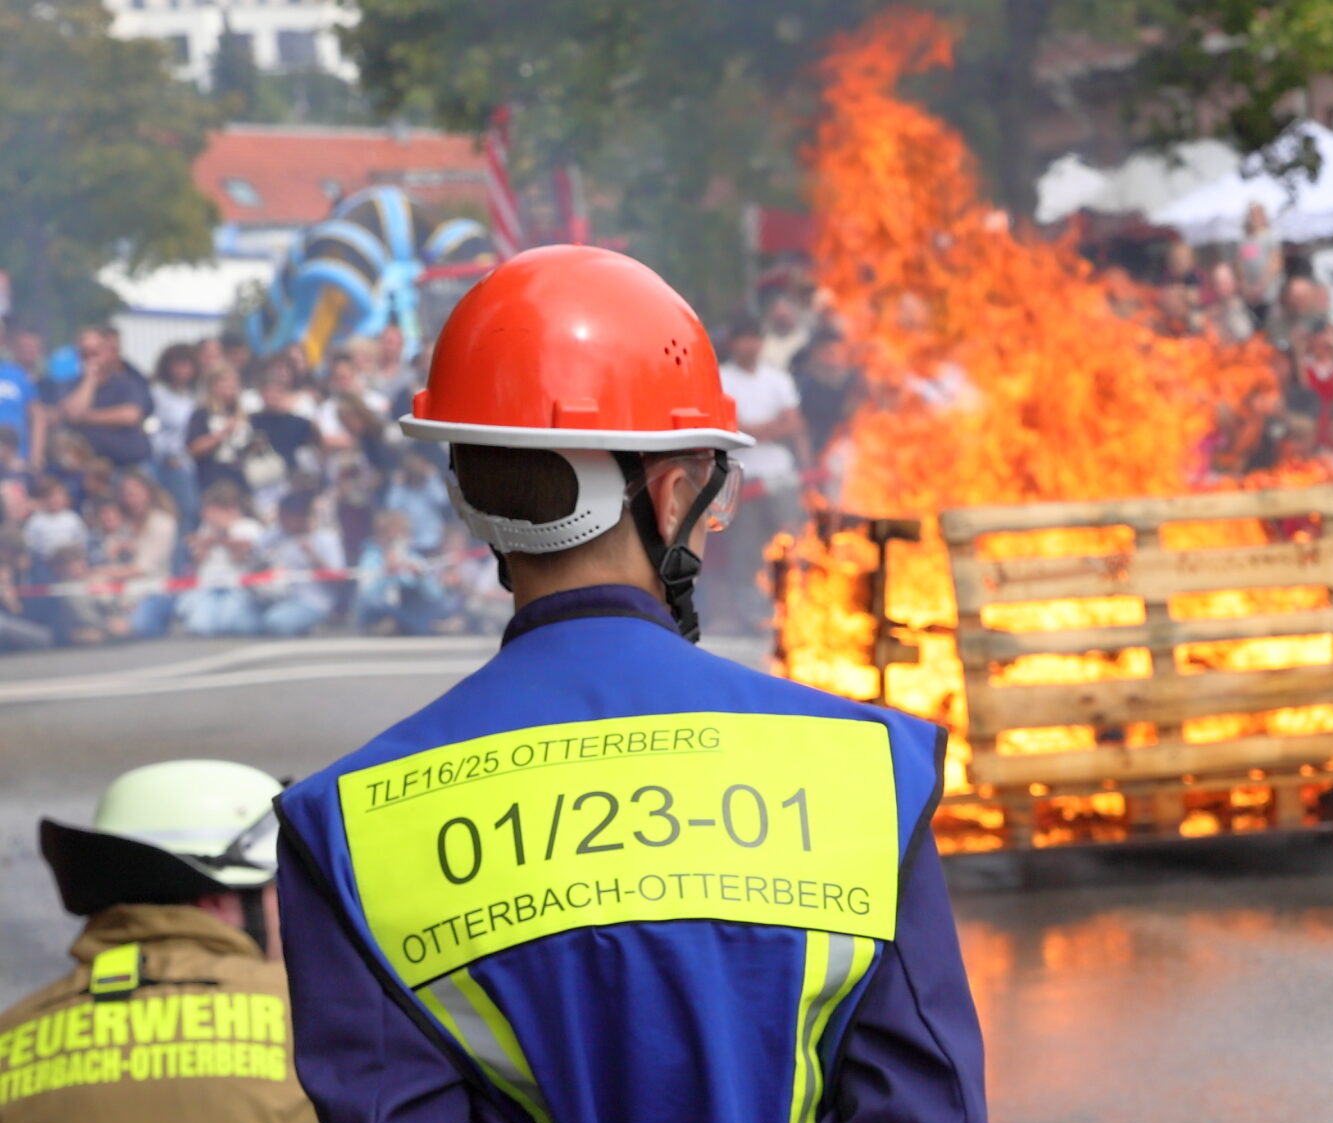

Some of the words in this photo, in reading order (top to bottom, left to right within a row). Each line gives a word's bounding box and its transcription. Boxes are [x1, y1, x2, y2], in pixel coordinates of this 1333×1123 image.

[366, 750, 500, 808] TLF16/25
[510, 727, 722, 769] OTTERBERG
[436, 783, 814, 886] 01/23-01
[402, 873, 871, 964] OTTERBACH-OTTERBERG
